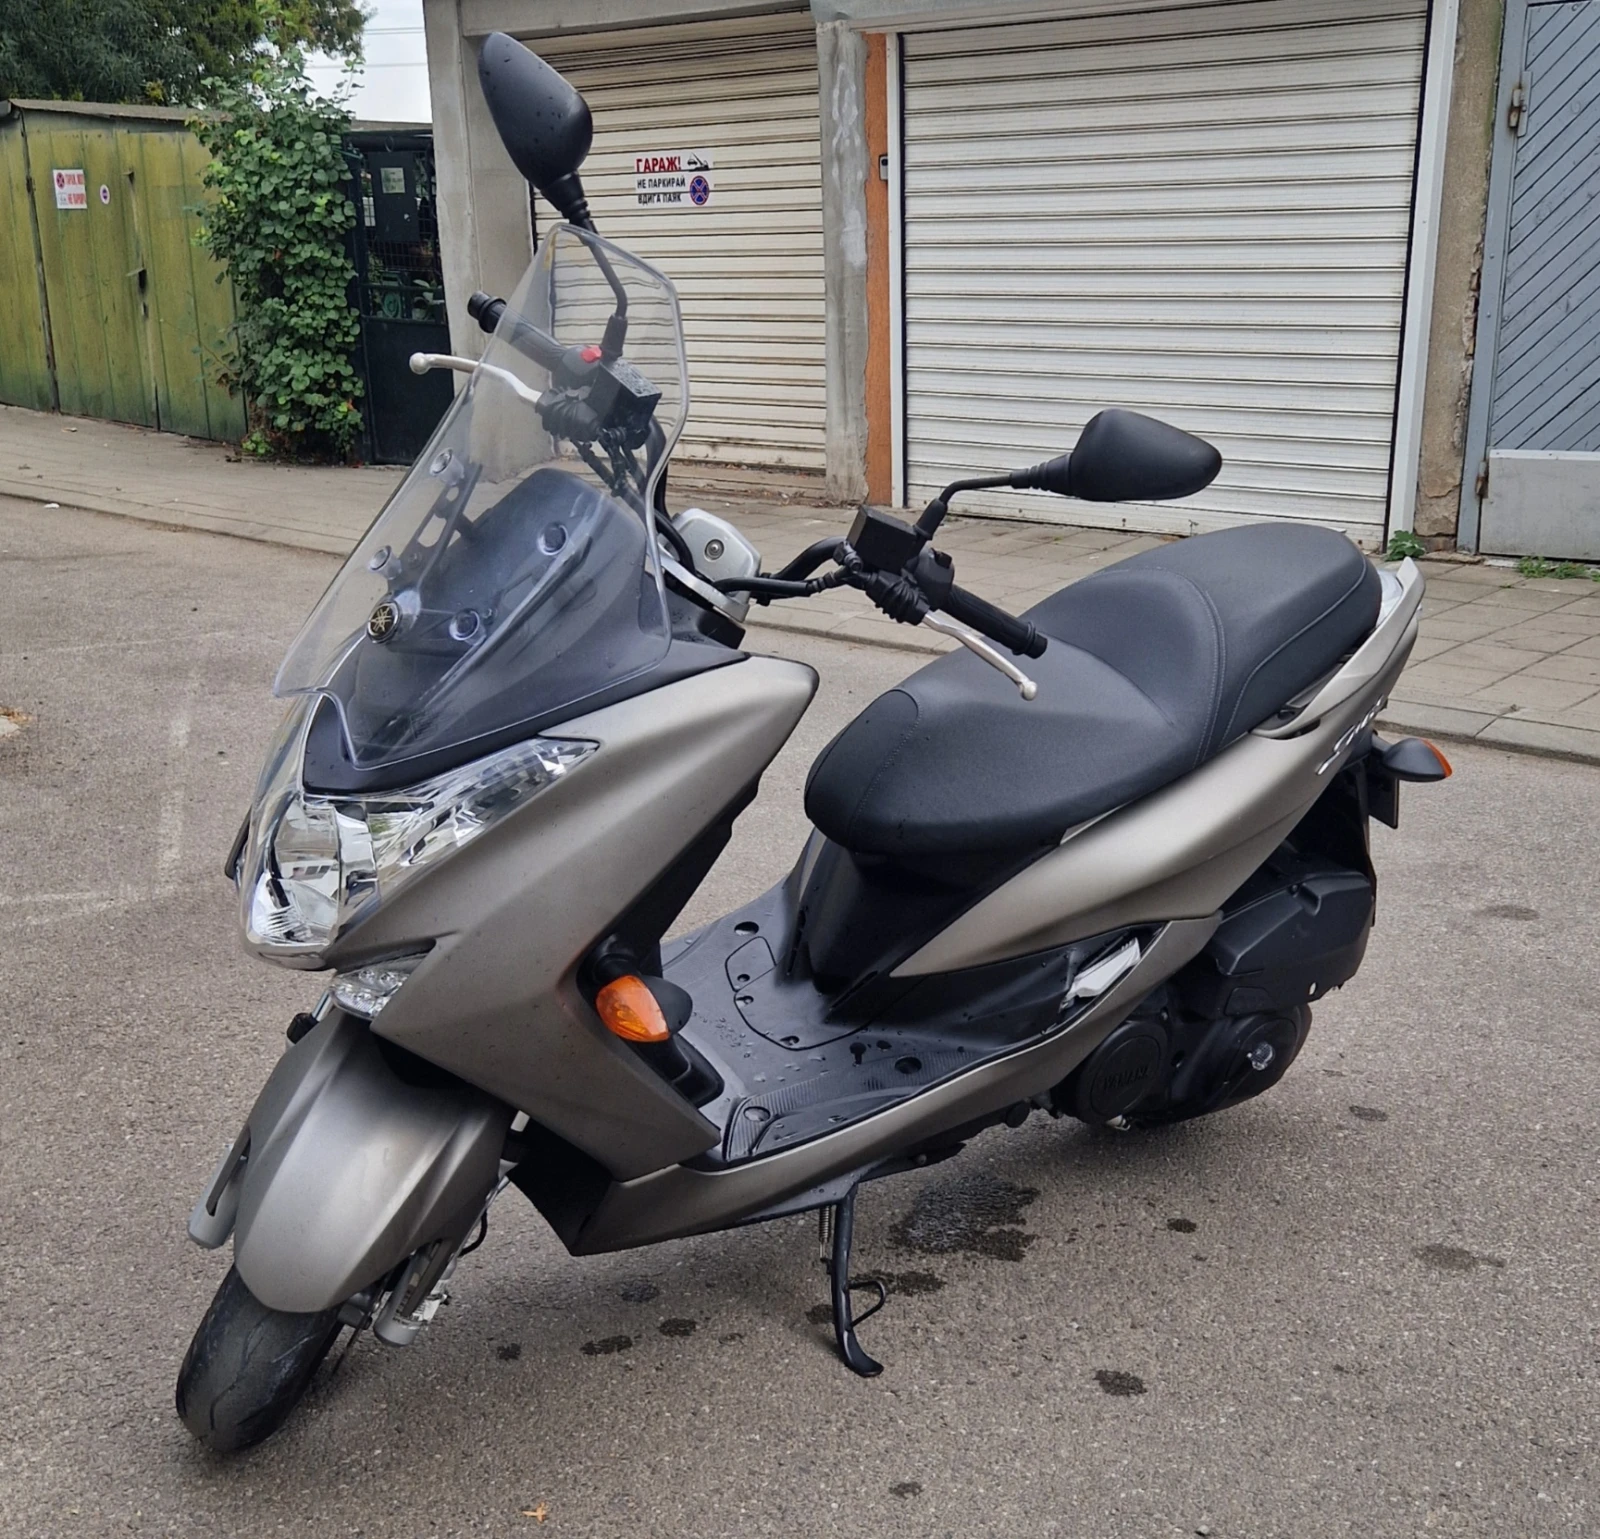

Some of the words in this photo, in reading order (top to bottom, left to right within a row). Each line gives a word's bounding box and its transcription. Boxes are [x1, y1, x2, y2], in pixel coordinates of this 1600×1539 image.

[636, 156, 682, 173] ГАРАЖ!
[637, 178, 647, 189] НЕ
[648, 175, 686, 188] ПАРКИРАЙ
[662, 192, 682, 203] ПАЯК
